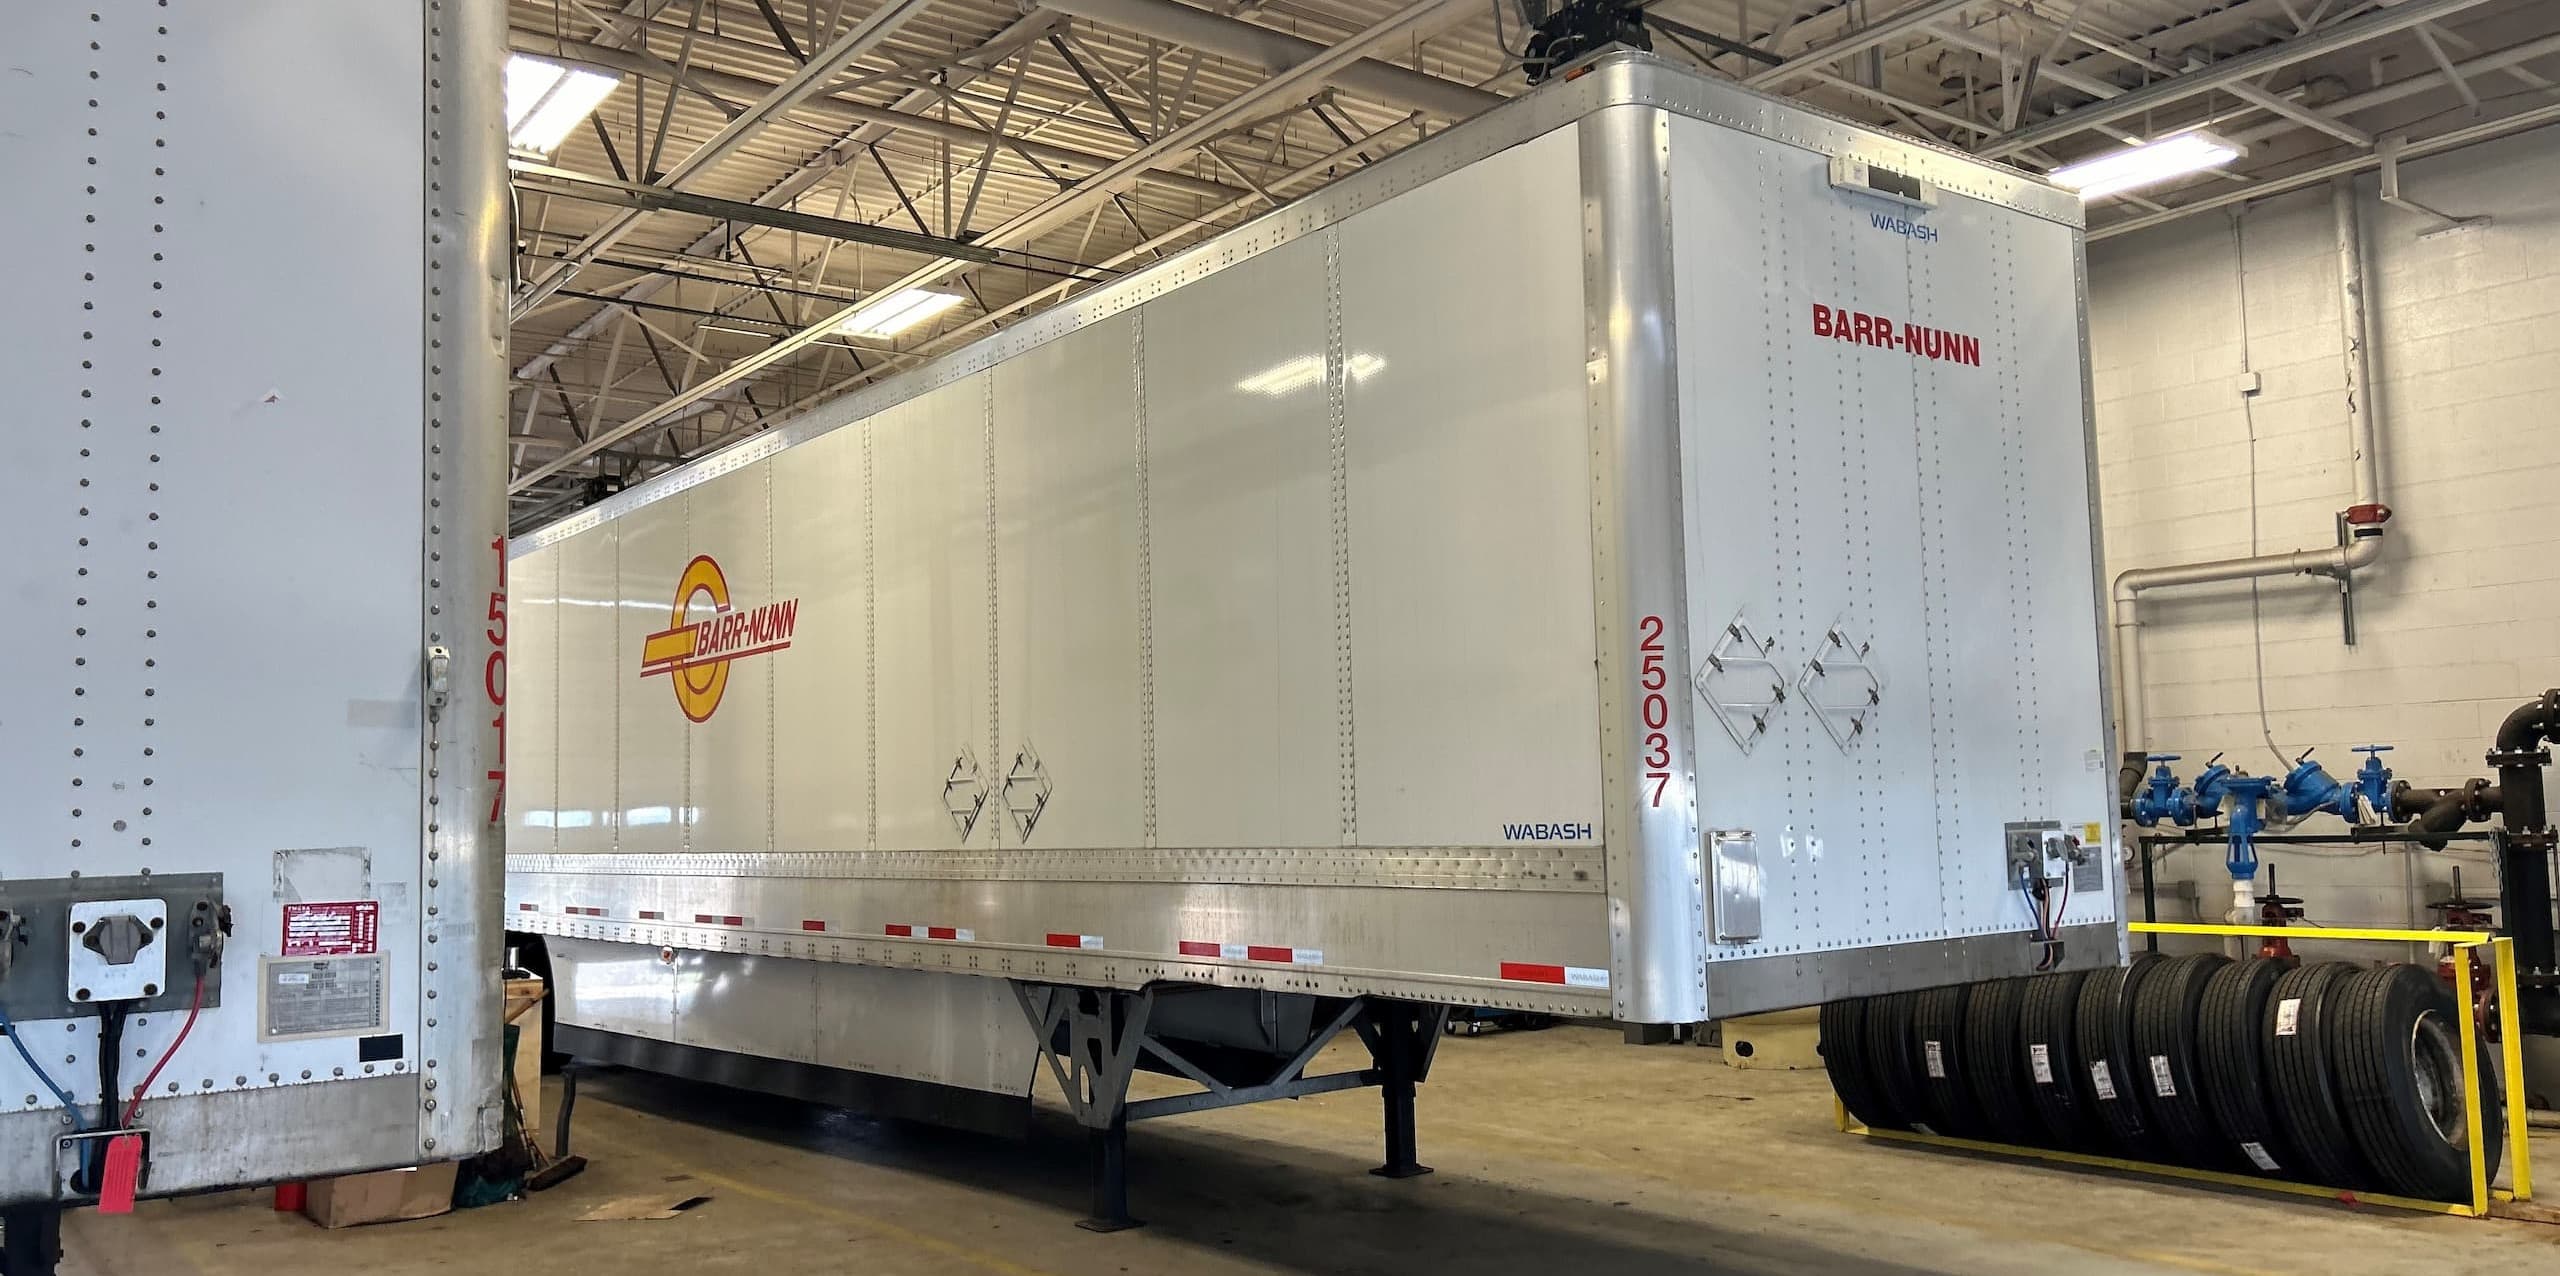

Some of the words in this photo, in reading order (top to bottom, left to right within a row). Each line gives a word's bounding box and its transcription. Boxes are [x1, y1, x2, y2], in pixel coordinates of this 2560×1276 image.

[1870, 212, 1938, 243] WABASH
[1812, 303, 1980, 367] BARR-NUNN
[697, 598, 798, 657] BARR-NUNN
[485, 535, 507, 823] 15017
[1640, 616, 1671, 808] 25037
[1503, 822, 1592, 840] WABASH
